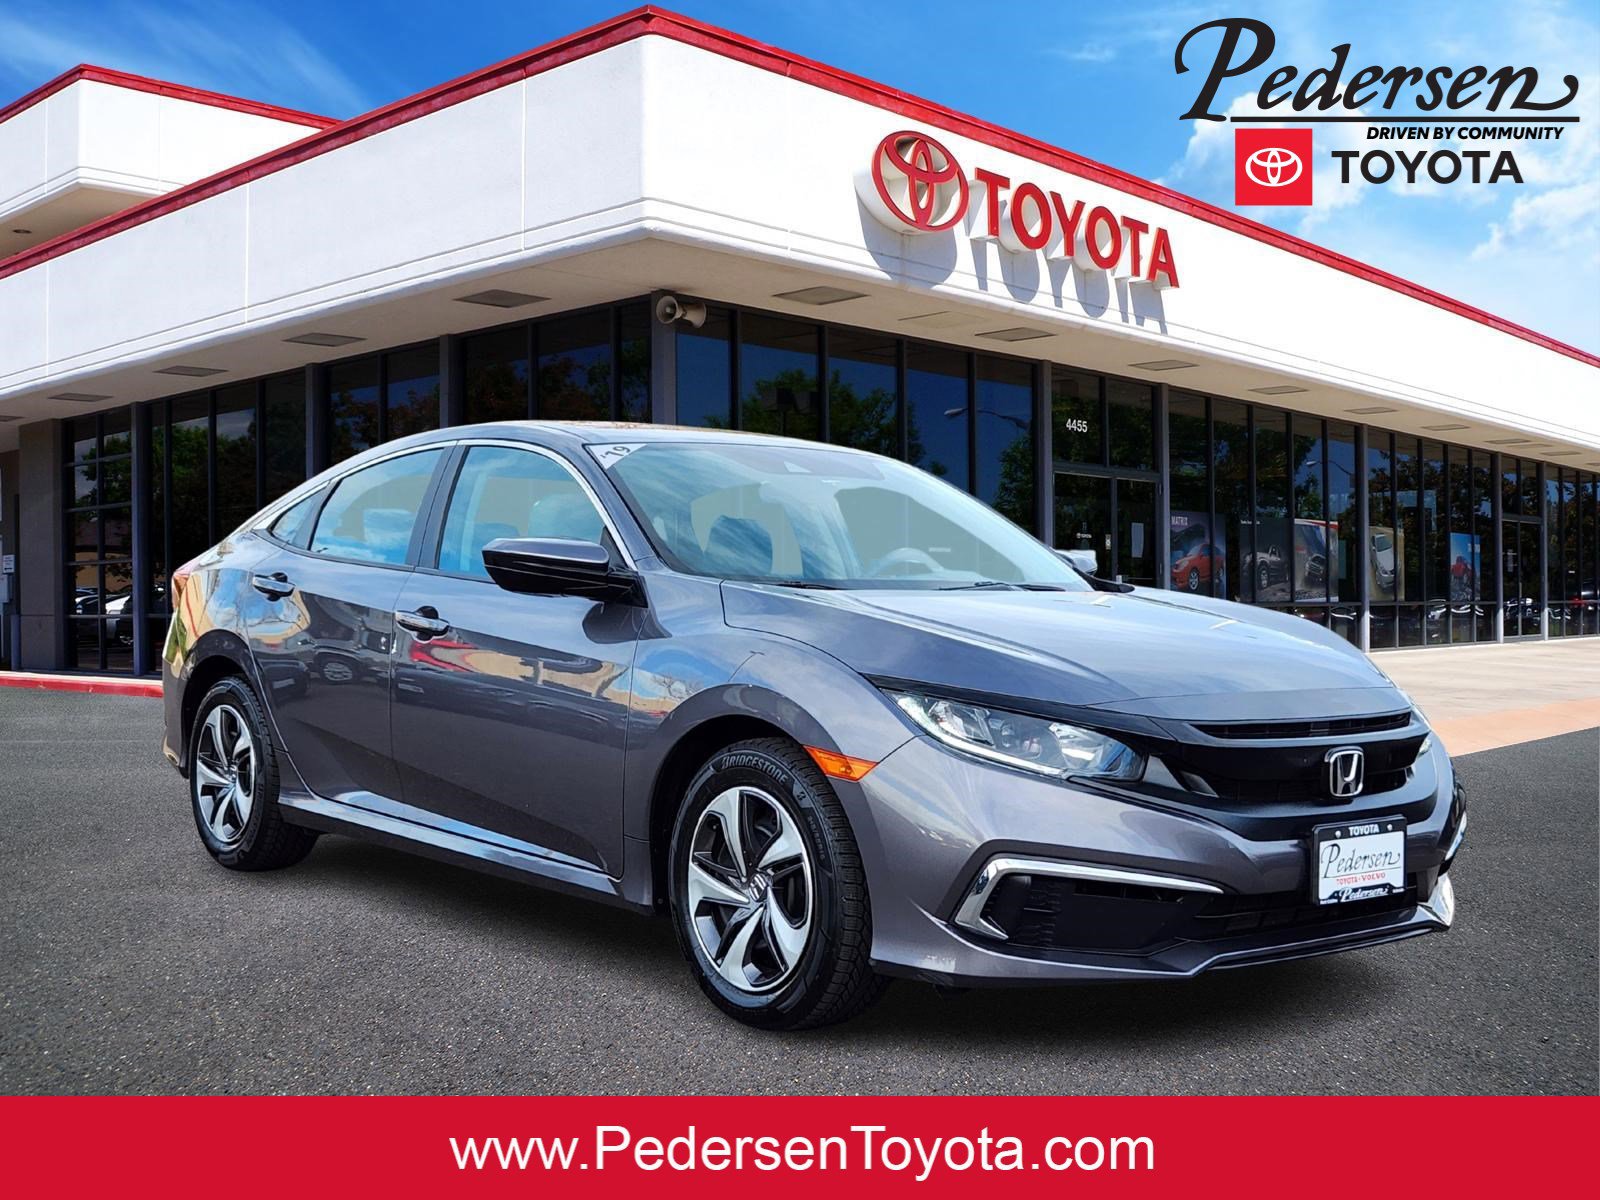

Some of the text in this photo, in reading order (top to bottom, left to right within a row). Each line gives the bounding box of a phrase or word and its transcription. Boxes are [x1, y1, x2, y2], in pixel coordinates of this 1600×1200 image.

[974, 167, 1180, 288] TOYOTA
[1066, 418, 1088, 433] 4455
[721, 755, 789, 784] BRIDGESTONE
[1348, 823, 1380, 836] TOYOTA
[1321, 843, 1401, 878] Pedersen
[1339, 886, 1389, 903] Pedersen
